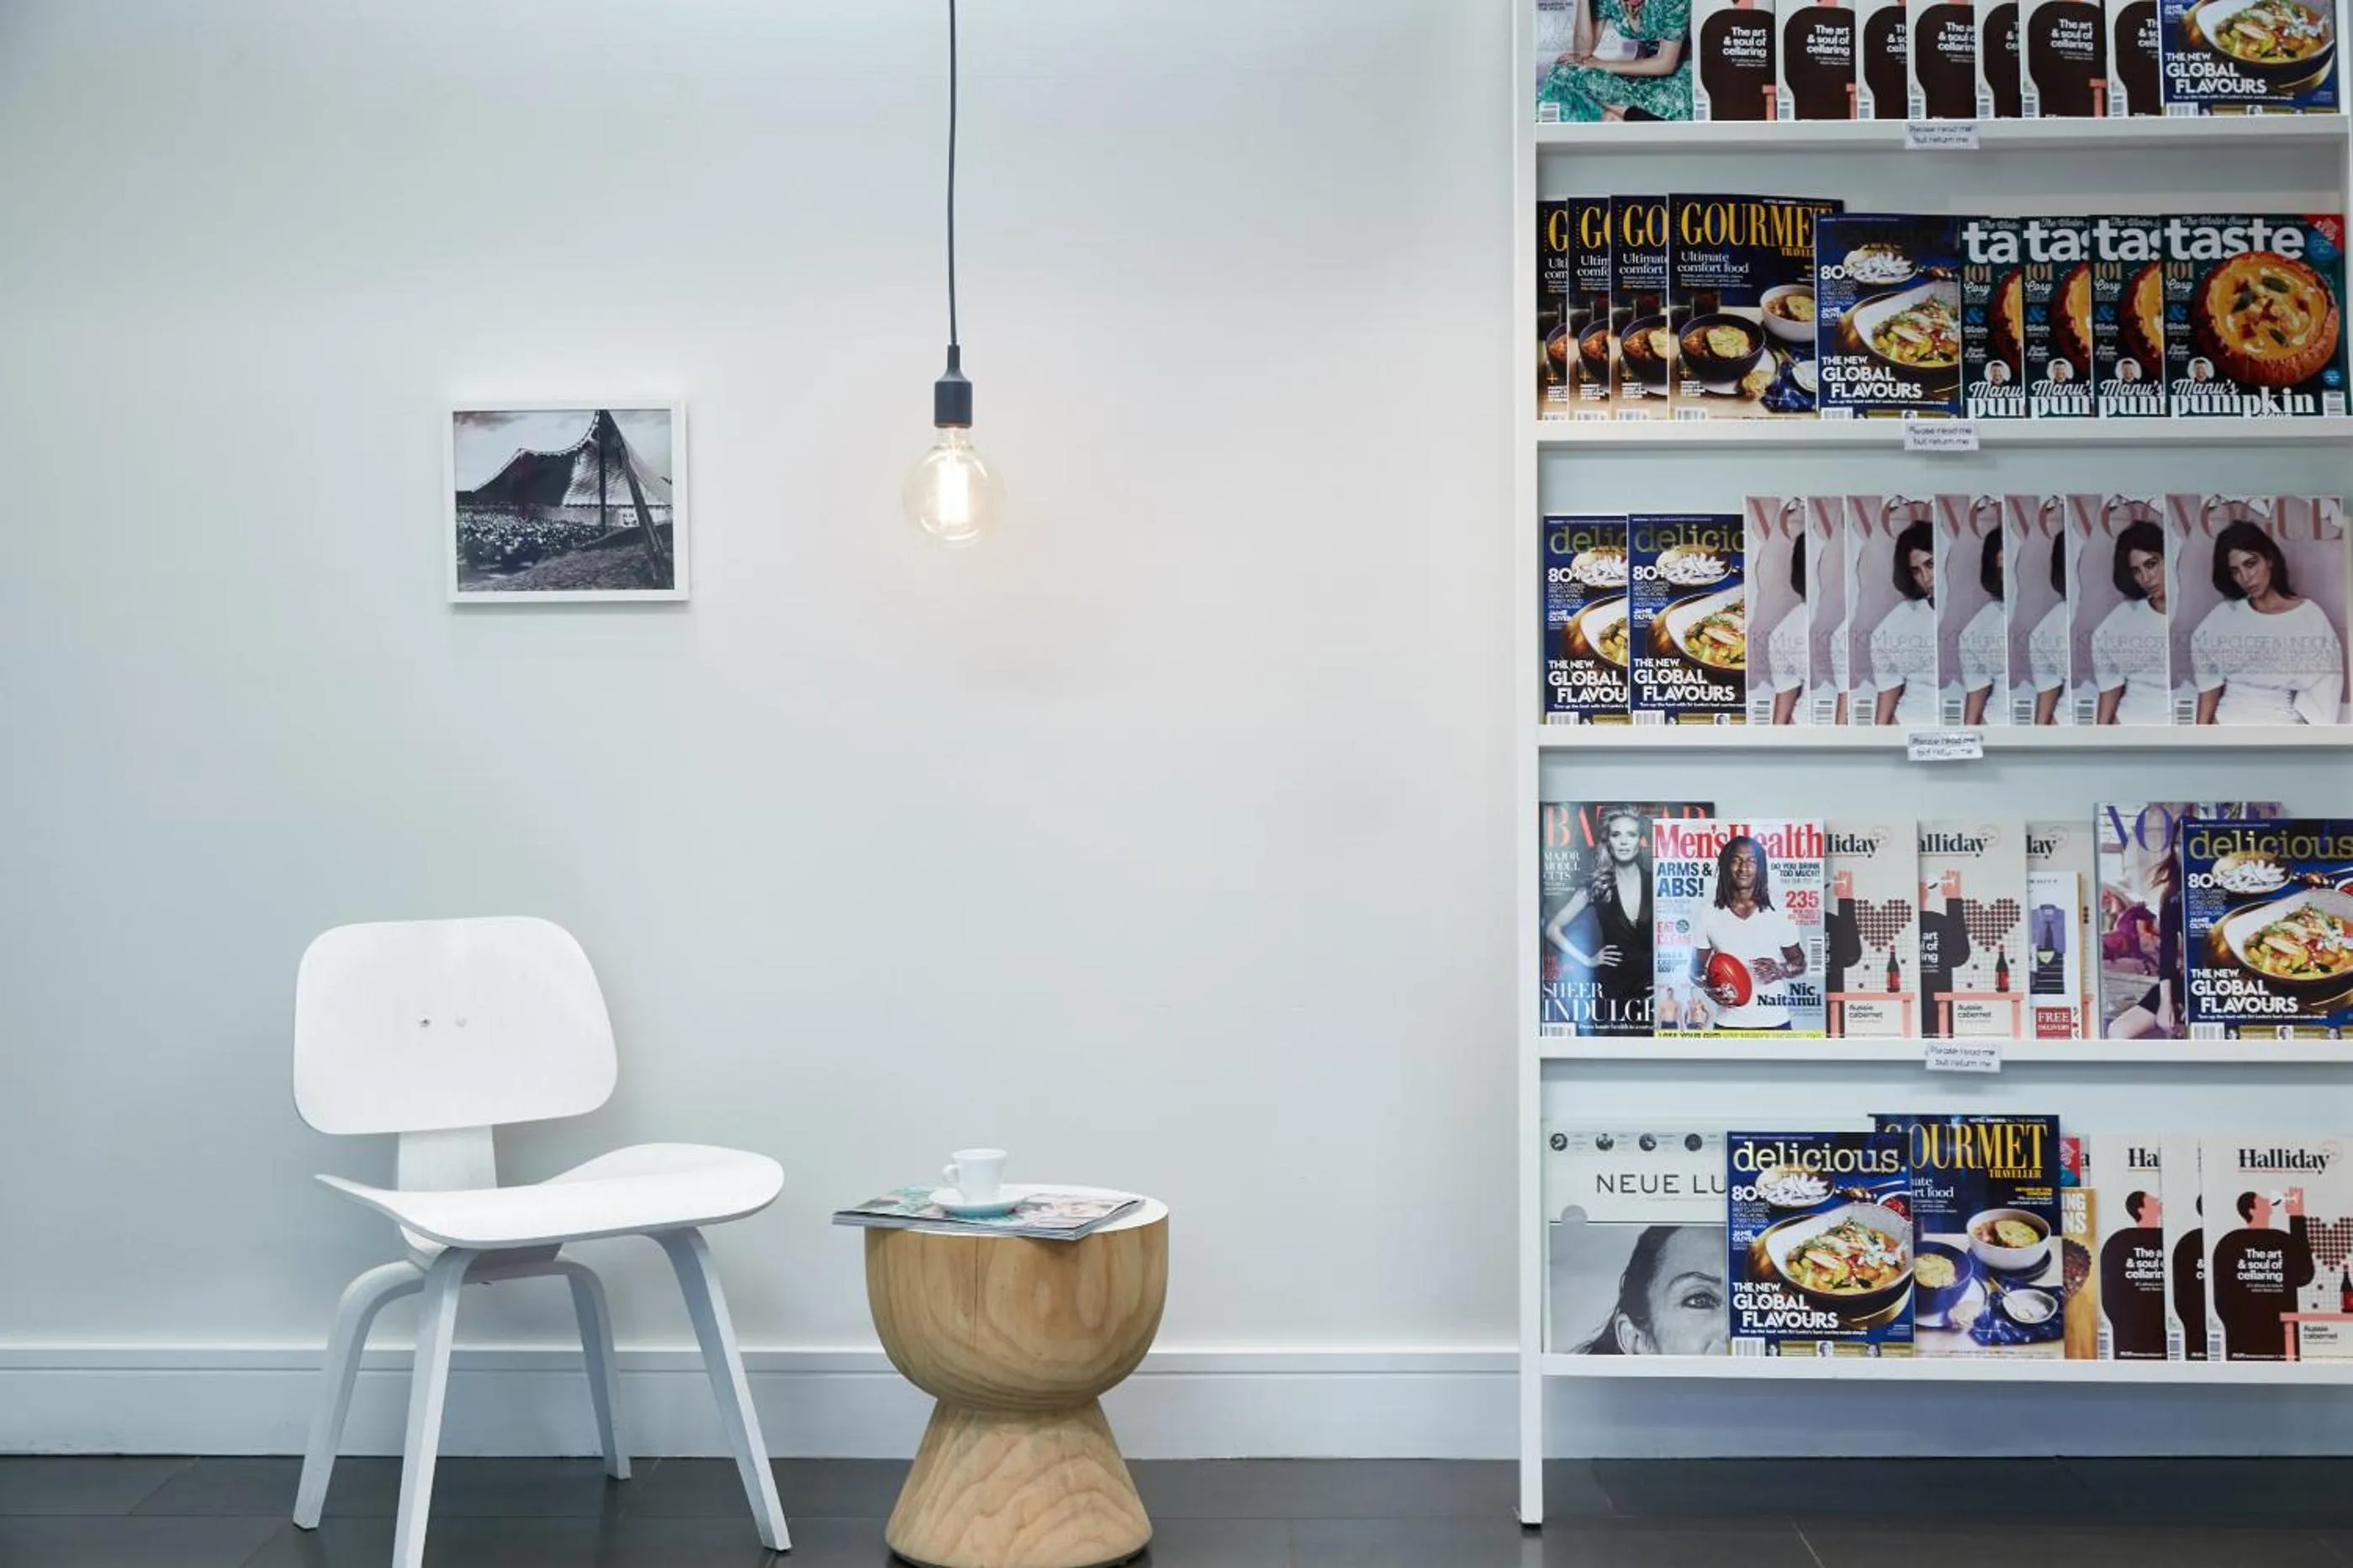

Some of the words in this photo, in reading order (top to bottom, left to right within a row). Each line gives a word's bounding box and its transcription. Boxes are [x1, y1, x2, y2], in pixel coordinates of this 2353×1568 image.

[1945, 22, 1964, 31] The
[2059, 18, 2075, 29] The
[2077, 20, 2092, 29] art
[1732, 27, 1750, 36] The
[1815, 25, 1833, 34] The
[1835, 27, 1850, 35] art
[2051, 29, 2060, 39] &
[2060, 29, 2081, 39] soul
[2082, 29, 2092, 39] of
[1723, 37, 1732, 45] &
[1733, 37, 1753, 45] soul
[1755, 37, 1766, 45] of
[1806, 34, 1815, 43] &
[1816, 34, 1838, 43] soul
[1839, 34, 1850, 44] of
[1938, 32, 1946, 41] &
[1948, 32, 1968, 41] soul
[1806, 44, 1850, 56] cellaring
[2050, 39, 2093, 51] cellaring
[1722, 46, 1766, 58] cellaring
[2165, 52, 2185, 61] THE
[2188, 52, 2211, 61] NEW
[2165, 63, 2239, 78] GLOBAL
[2175, 79, 2267, 94] FLAVOURS
[1681, 202, 1832, 248] GOURME
[2165, 219, 2305, 261] taste
[1680, 251, 1729, 264] Ultimate
[1619, 263, 1664, 275] comfort
[1677, 262, 1722, 273] comfort
[1724, 262, 1749, 273] food
[1822, 356, 1841, 365] THE
[1844, 356, 1868, 365] NEW
[1822, 367, 1896, 382] GLOBAL
[1831, 383, 1922, 399] FLAVOURS
[2172, 378, 2239, 396] Manu's
[2170, 386, 2315, 419] pumpkin
[2165, 494, 2344, 541] VOGUE
[1548, 660, 1568, 668] THE
[1571, 660, 1594, 668] NEW
[1633, 658, 1653, 667] THE
[1656, 658, 1680, 667] NEW
[1548, 671, 1622, 686] GLOBAL
[1633, 668, 1708, 684] GLOBAL
[1557, 686, 1627, 703] FLAVOU
[1642, 685, 1736, 701] FLAVOURS
[1652, 824, 1727, 858] Men's
[1657, 862, 1699, 876] ARMS
[1701, 862, 1712, 876] &
[1657, 879, 1705, 898] ABS!
[1786, 890, 1819, 908] 235
[1922, 932, 1938, 942] art
[2190, 969, 2211, 978] THE
[2213, 969, 2239, 978] NEW
[1543, 982, 1603, 999] SHEER
[1789, 983, 1815, 996] Nic
[2191, 980, 2269, 996] GLOBAL
[1757, 995, 1822, 1007] Naitanui
[2201, 997, 2298, 1013] FLAVOURS
[2038, 1011, 2070, 1022] FREE
[1885, 1123, 2048, 1170] OURMET
[2239, 1147, 2330, 1175] Halliday
[1989, 1169, 2042, 1179] TRAVELLER
[1596, 1175, 1680, 1194] NEUE
[1927, 1186, 1954, 1197] food
[2134, 1248, 2155, 1258] The
[2246, 1249, 2266, 1259] The
[2126, 1259, 2134, 1268] &
[2136, 1259, 2159, 1268] soul
[2238, 1260, 2246, 1270] &
[2248, 1260, 2271, 1270] soul
[2271, 1260, 2283, 1270] of
[2237, 1270, 2283, 1283] cellaring
[1732, 1283, 1752, 1292] THE
[1756, 1283, 1781, 1292] NEW
[1732, 1294, 1810, 1310] GLOBAL
[1742, 1312, 1839, 1328] FLAVOURS
